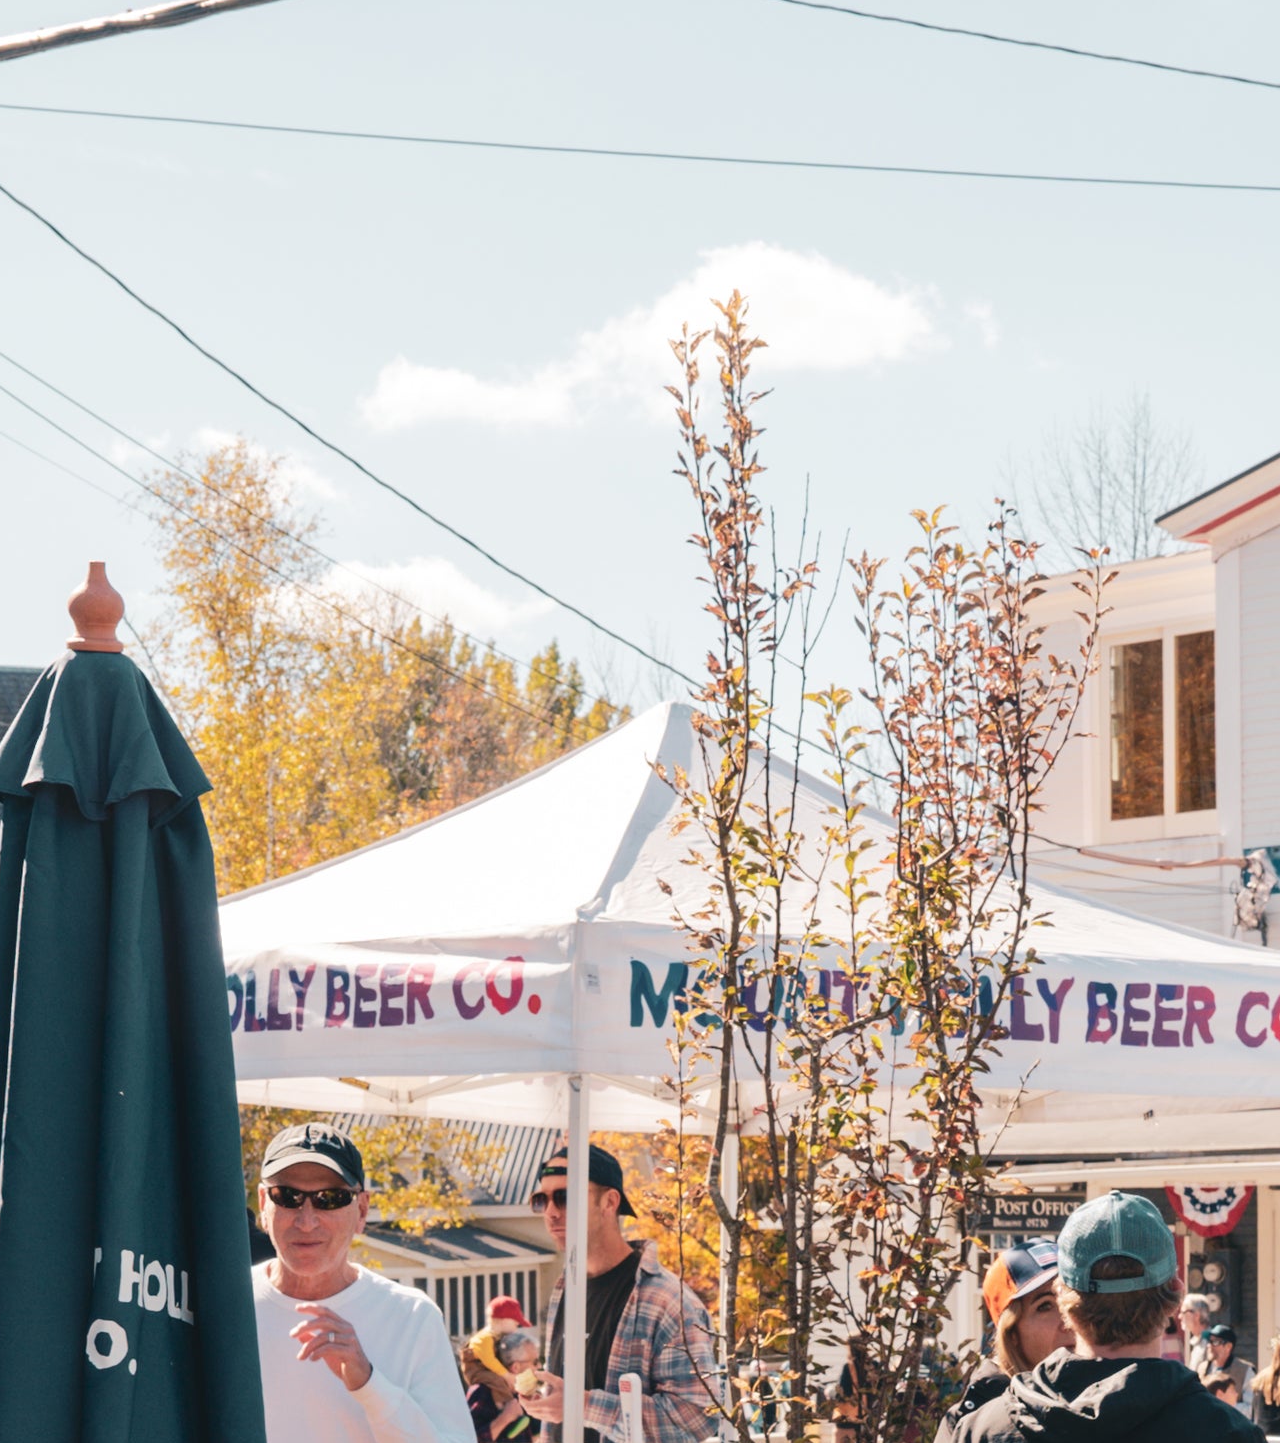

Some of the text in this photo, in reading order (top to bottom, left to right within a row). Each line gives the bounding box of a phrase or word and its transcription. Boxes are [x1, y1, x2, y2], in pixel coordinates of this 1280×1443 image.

[227, 955, 542, 1032] OLLY BEER CO.
[1085, 981, 1216, 1048] BEER
[995, 1198, 1029, 1216] POST
[118, 1249, 194, 1326] HOLL
[86, 1318, 138, 1376] O.
